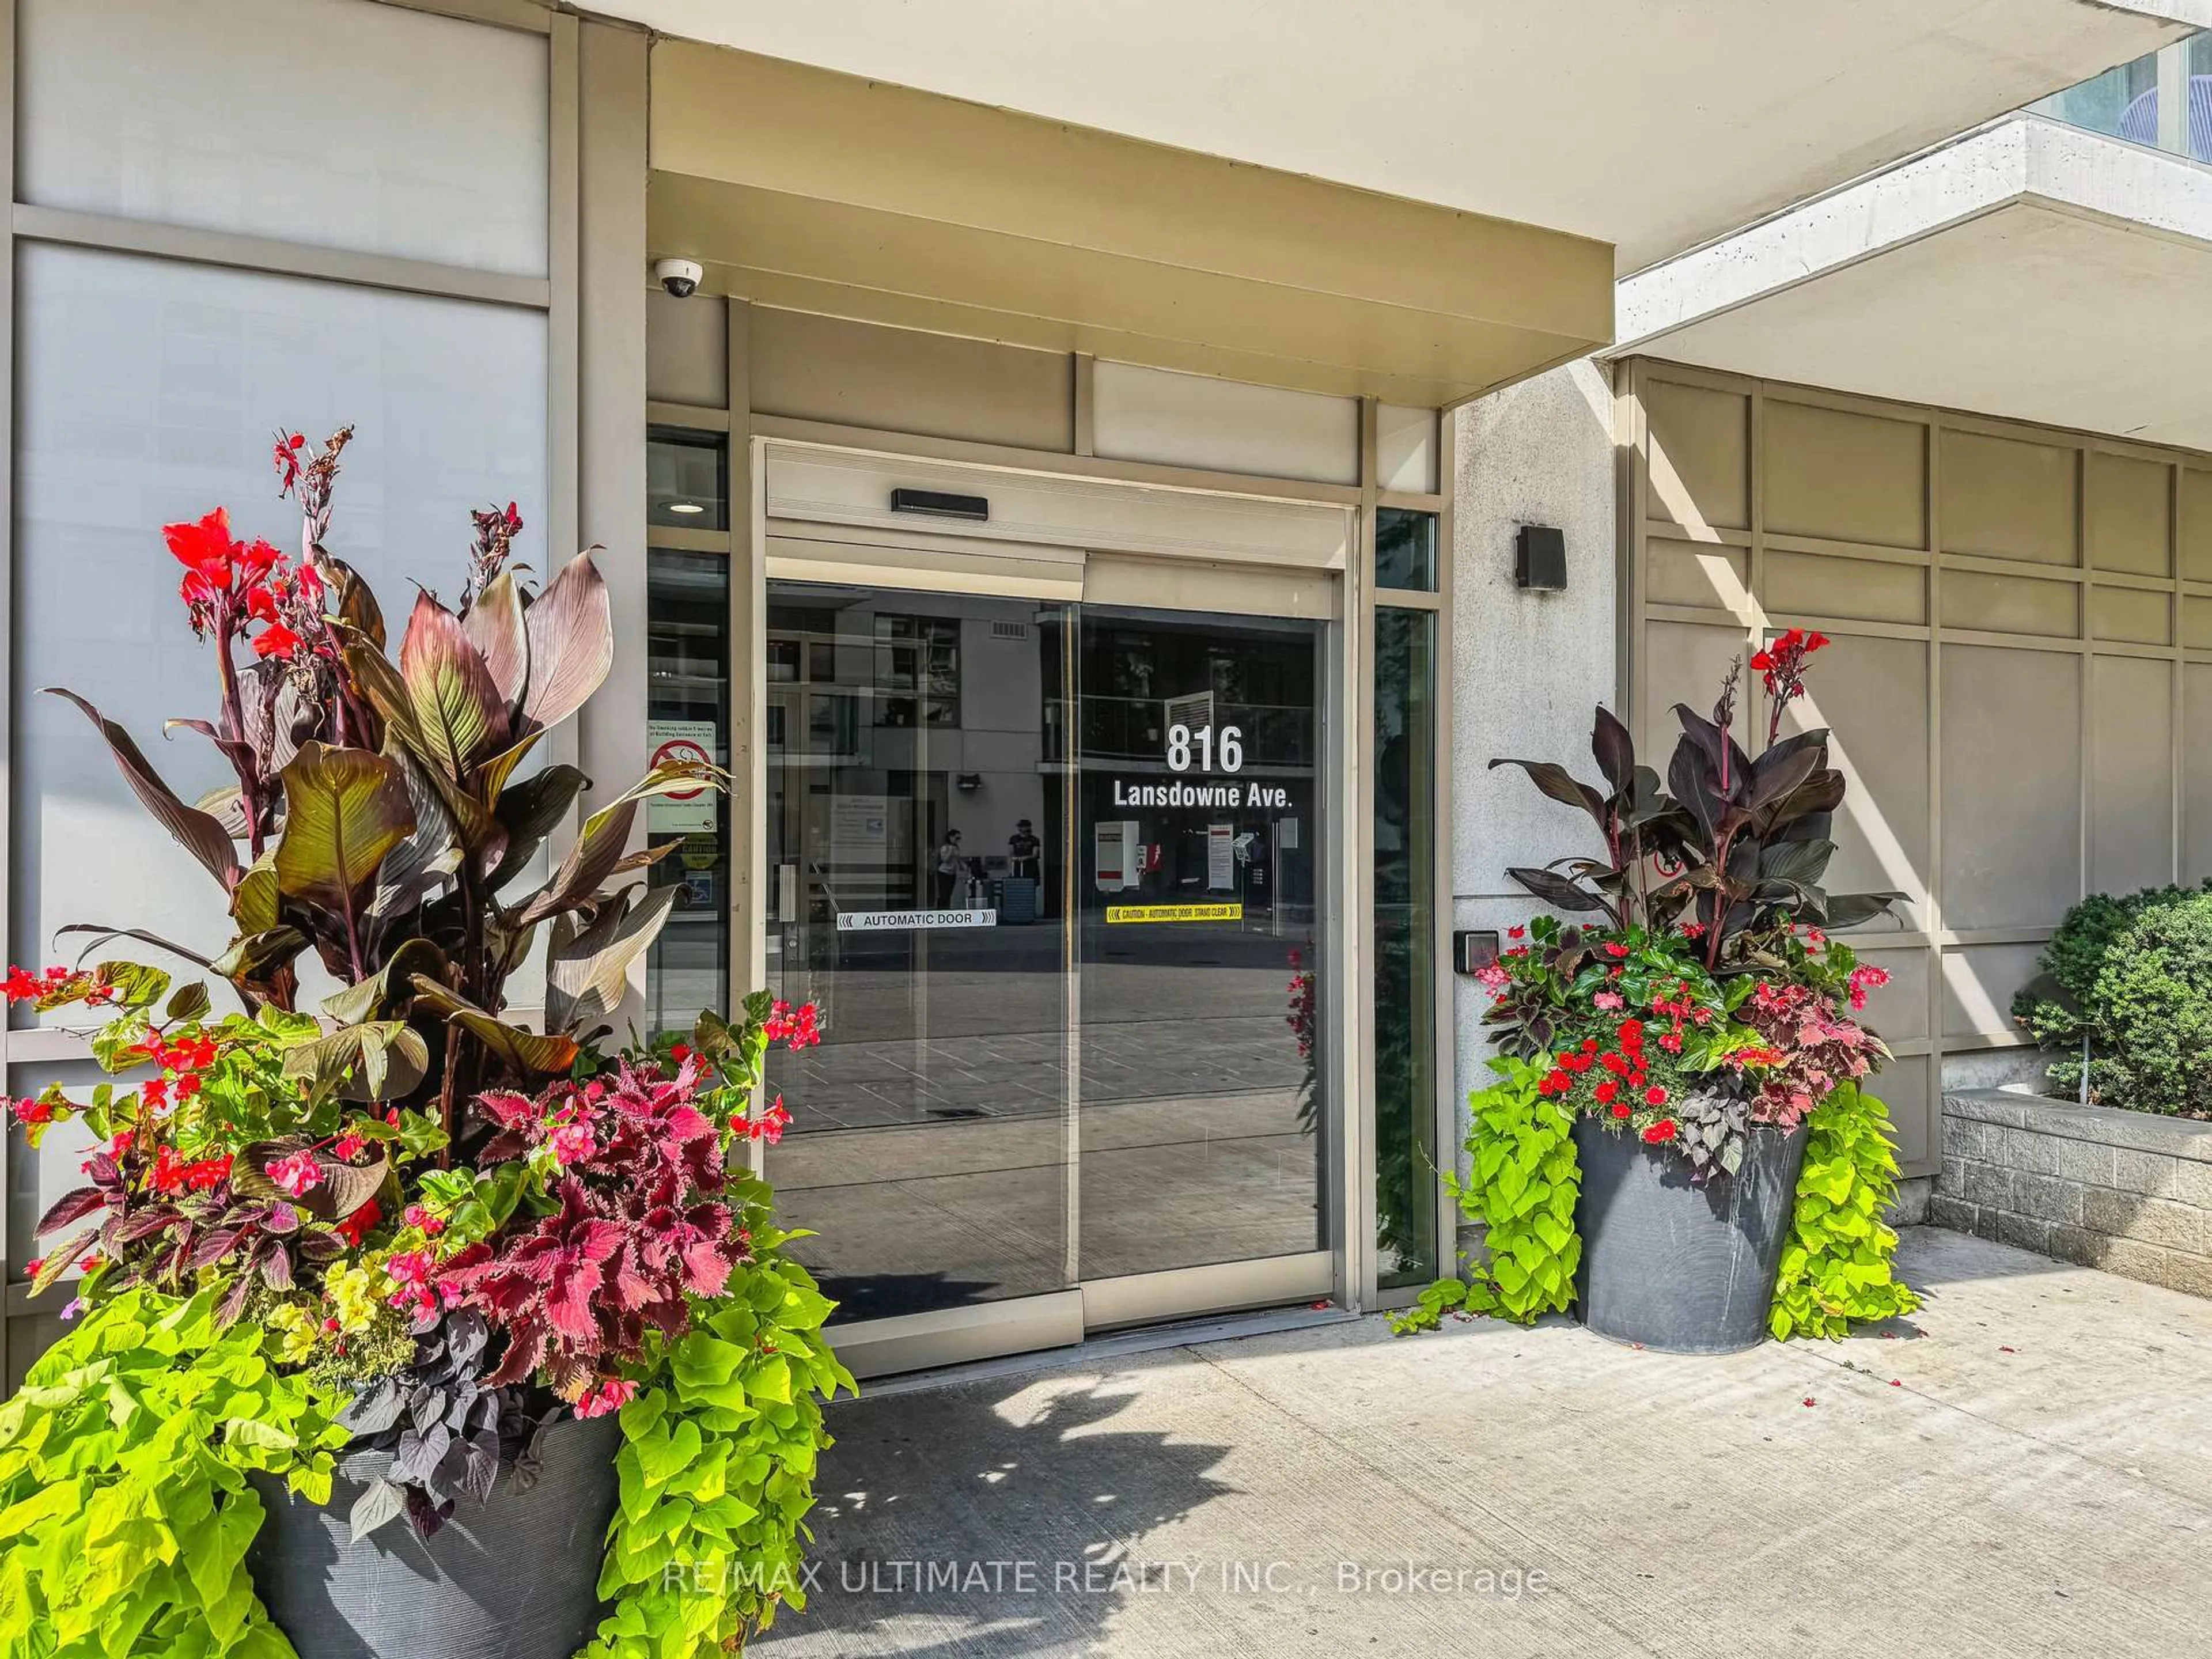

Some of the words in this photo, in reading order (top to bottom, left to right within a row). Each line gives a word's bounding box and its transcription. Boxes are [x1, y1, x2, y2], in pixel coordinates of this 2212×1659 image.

[1167, 724, 1243, 773] 816
[1114, 780, 1240, 807] Lansdowne
[1247, 782, 1293, 808] Ave.
[864, 915, 934, 926] AUTOMATIC
[938, 914, 972, 924] DOOR
[1123, 910, 1145, 919] CAUTION
[1149, 909, 1177, 918] AUTOMATIC
[1179, 908, 1192, 917] DOOR
[1211, 907, 1227, 916] CLEAR
